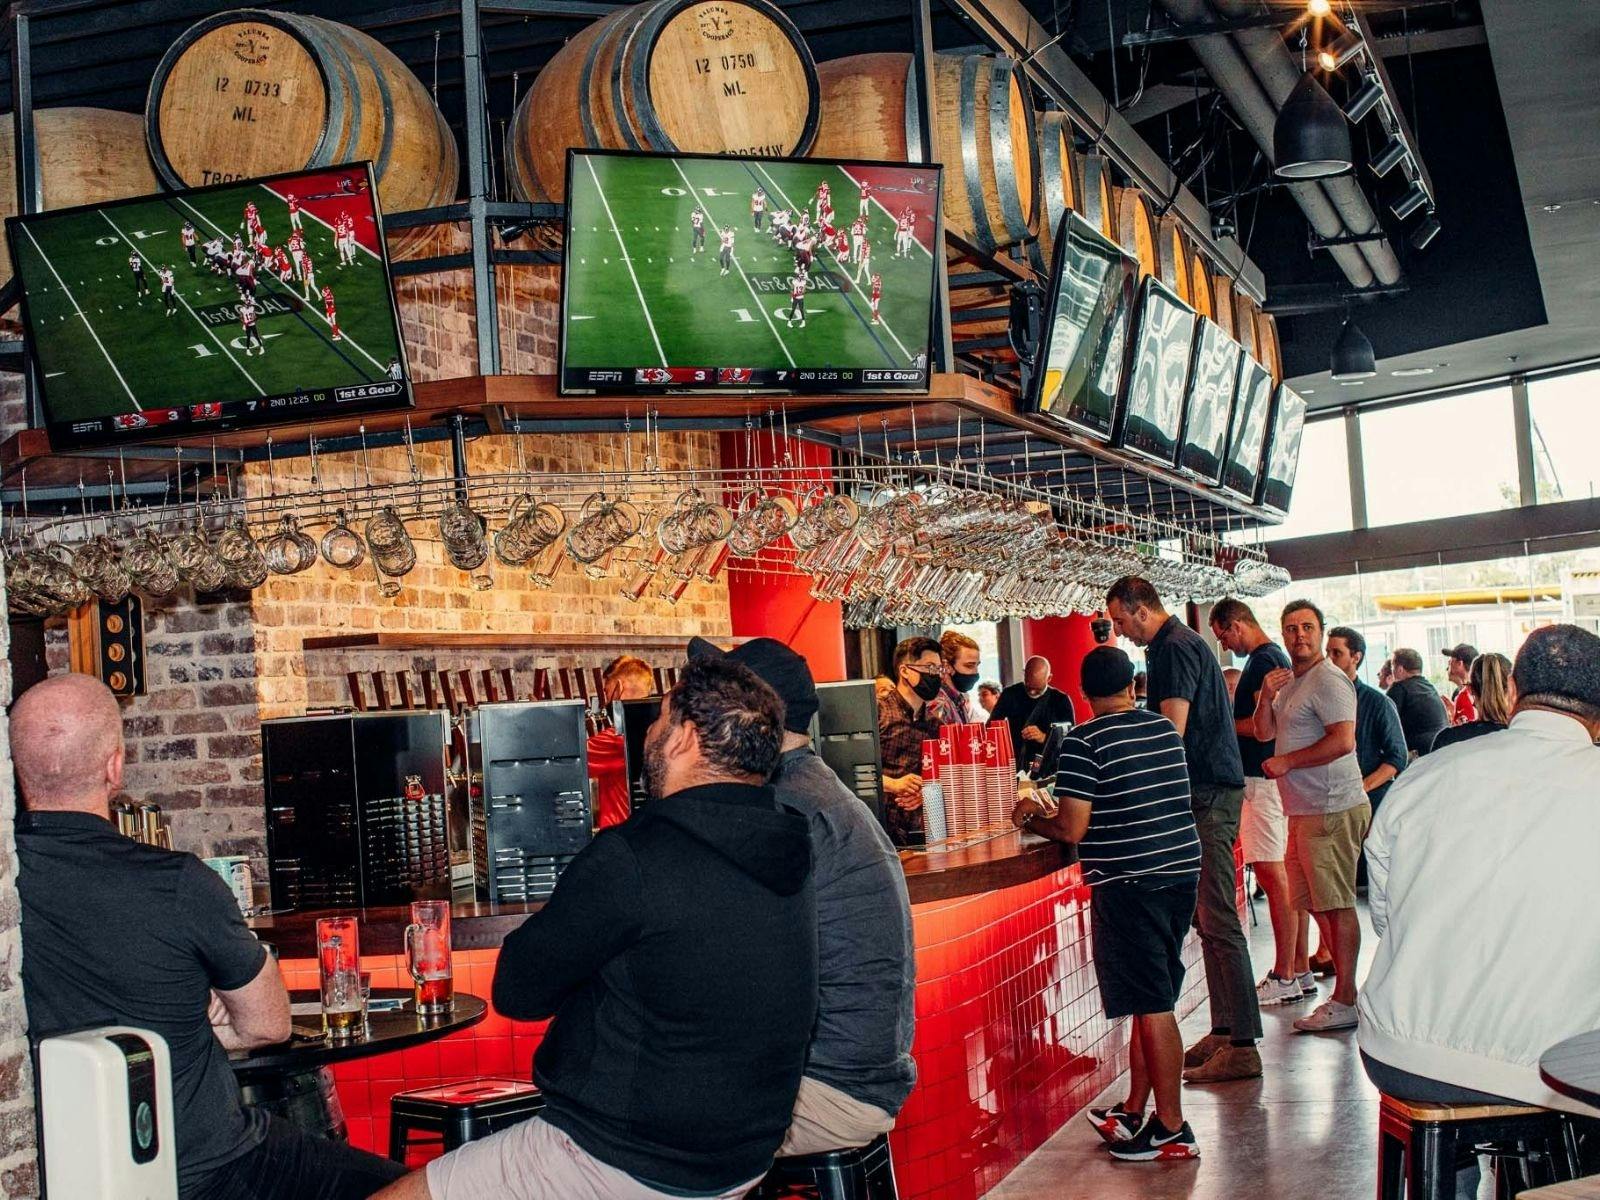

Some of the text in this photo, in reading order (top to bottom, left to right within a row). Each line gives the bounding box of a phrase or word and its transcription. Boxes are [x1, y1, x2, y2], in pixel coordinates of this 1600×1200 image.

[695, 53, 755, 74] 12 0750
[215, 77, 281, 97] 12 0733
[722, 81, 746, 97] ML
[232, 106, 256, 122] ML
[588, 371, 623, 381] ESPN
[694, 370, 706, 381] 3
[776, 371, 787, 381] 7
[800, 372, 815, 380] 2ND
[818, 372, 838, 380] 12:25
[866, 372, 882, 380] 1st
[883, 372, 892, 380] &
[893, 372, 919, 380] Goal
[72, 421, 103, 433] ESPN
[167, 410, 179, 421] 3
[246, 400, 257, 411] 7
[270, 398, 286, 408] 2ND
[288, 395, 309, 405] 12:25
[339, 389, 355, 399] 1st
[357, 388, 367, 397] &
[368, 385, 396, 396] Goal
